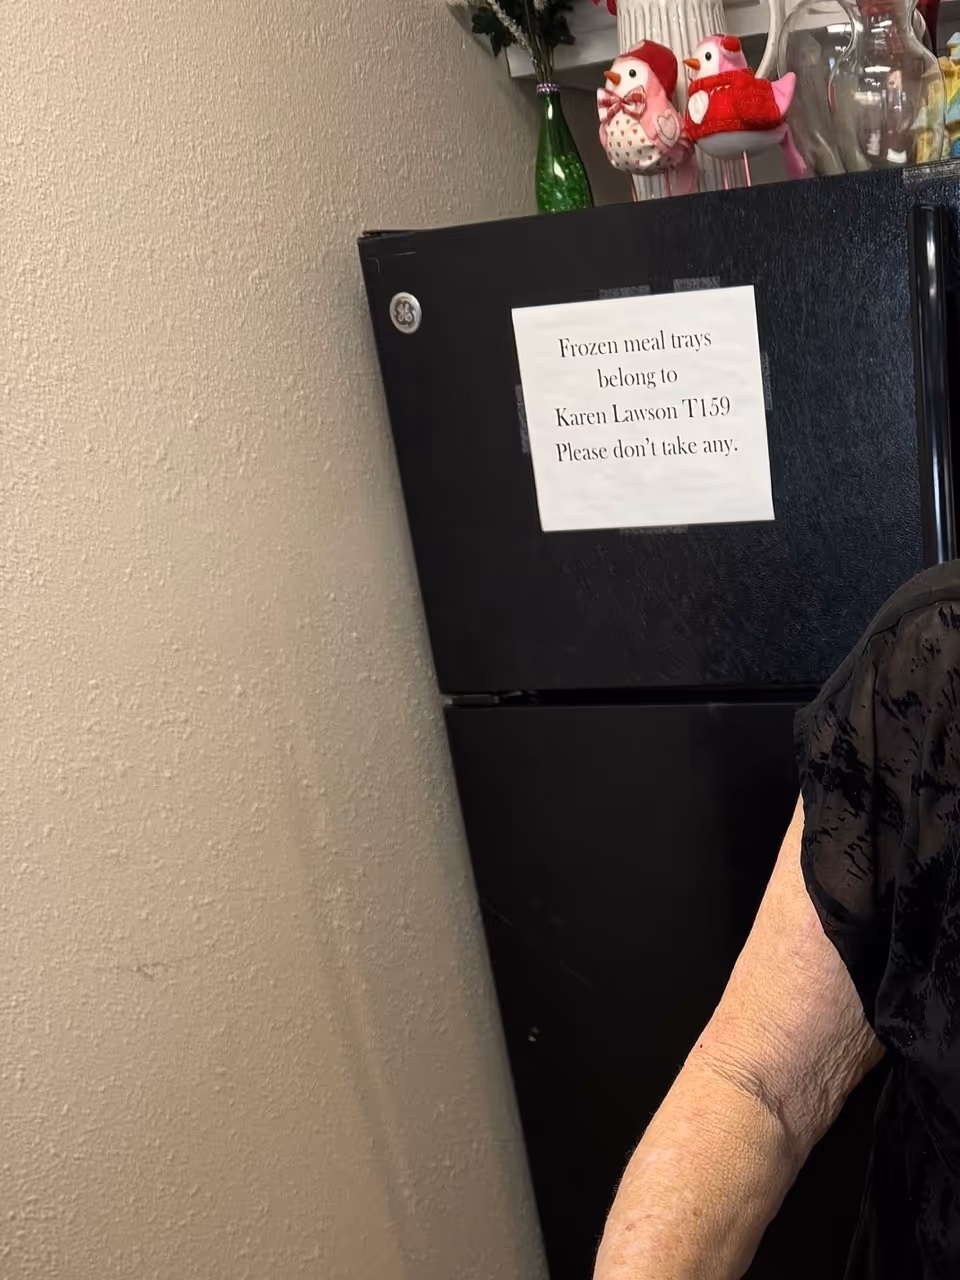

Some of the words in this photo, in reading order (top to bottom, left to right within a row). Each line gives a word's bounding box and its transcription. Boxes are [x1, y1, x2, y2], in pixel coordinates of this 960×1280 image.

[558, 337, 619, 358] Frozen
[623, 330, 666, 353] meal
[671, 332, 712, 352] trays
[597, 367, 657, 389] belong
[661, 368, 678, 384] to
[554, 407, 607, 427] Karen
[612, 404, 678, 423] Lawson
[682, 396, 731, 418] T159
[555, 442, 608, 462] Please
[613, 437, 657, 459] don't
[662, 436, 698, 456] take
[702, 438, 739, 457] any.
